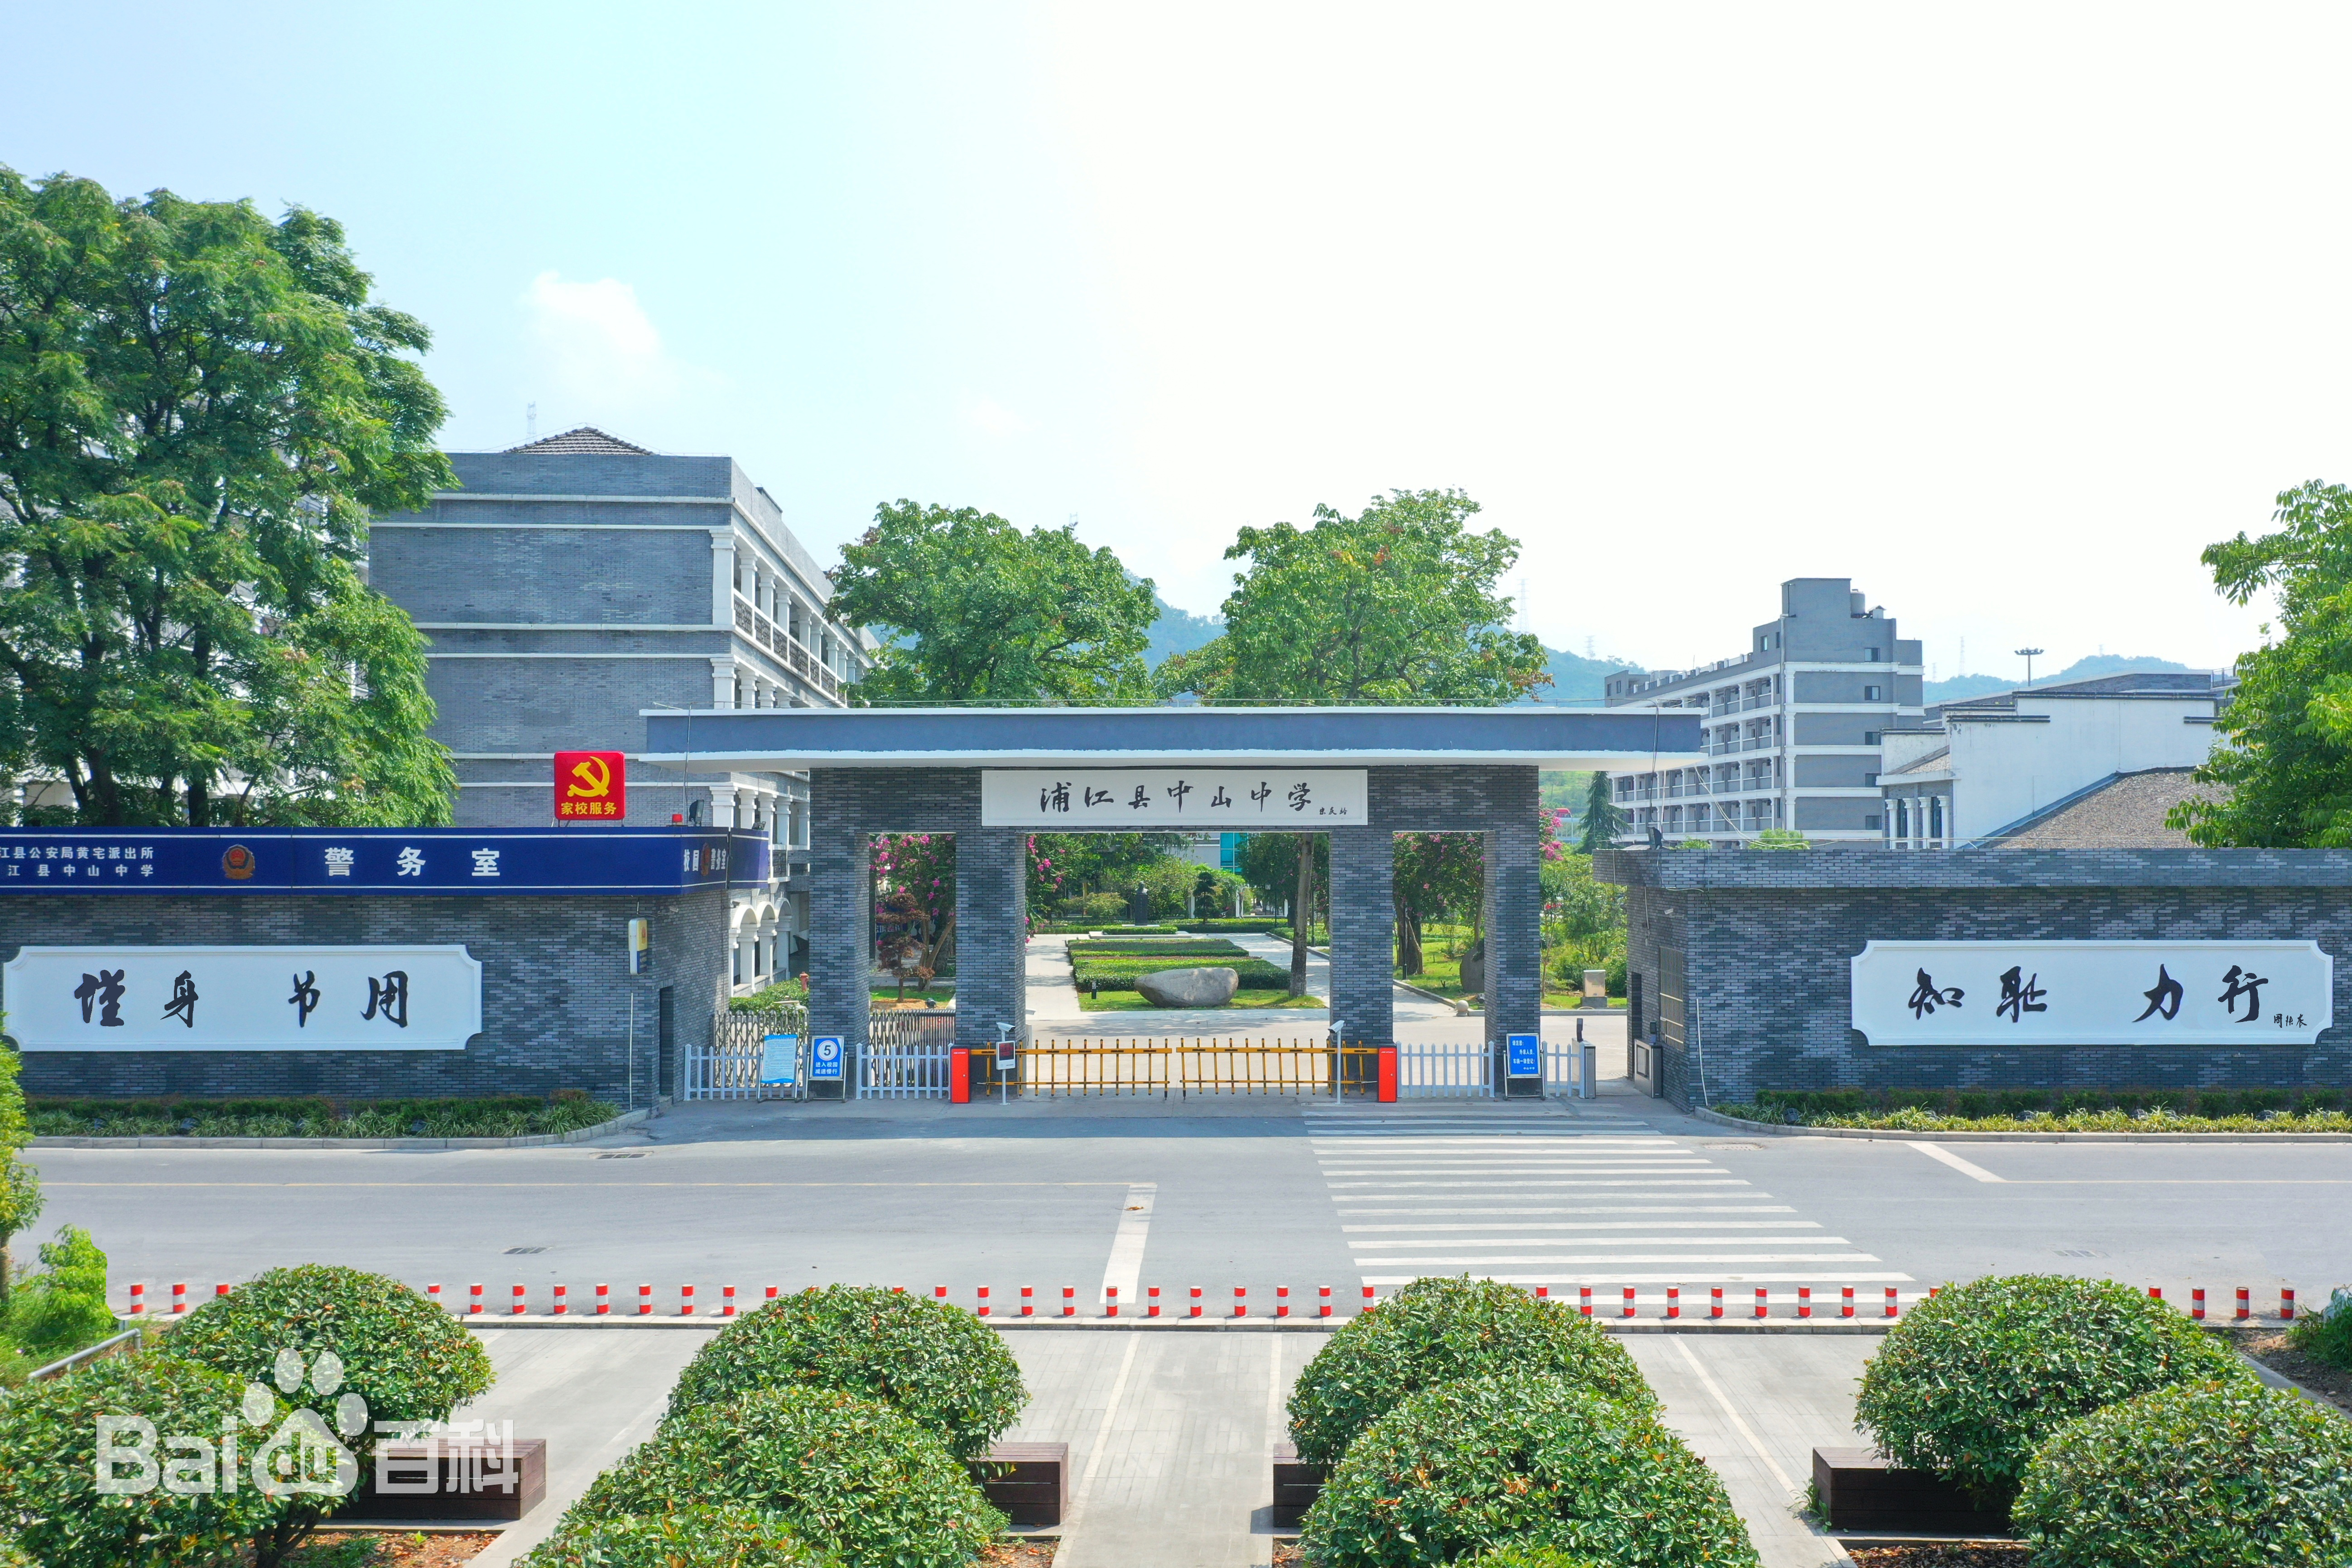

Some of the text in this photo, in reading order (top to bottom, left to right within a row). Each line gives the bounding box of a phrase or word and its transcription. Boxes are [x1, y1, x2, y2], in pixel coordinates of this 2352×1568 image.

[1040, 780, 1312, 813] 浦江县中山中学
[561, 801, 617, 815] 家校服务
[0, 847, 154, 859] 江县公安局黄宅派出所
[324, 847, 500, 876] 警务室
[8, 864, 153, 877] 江县中山中学
[823, 1045, 831, 1056] 5
